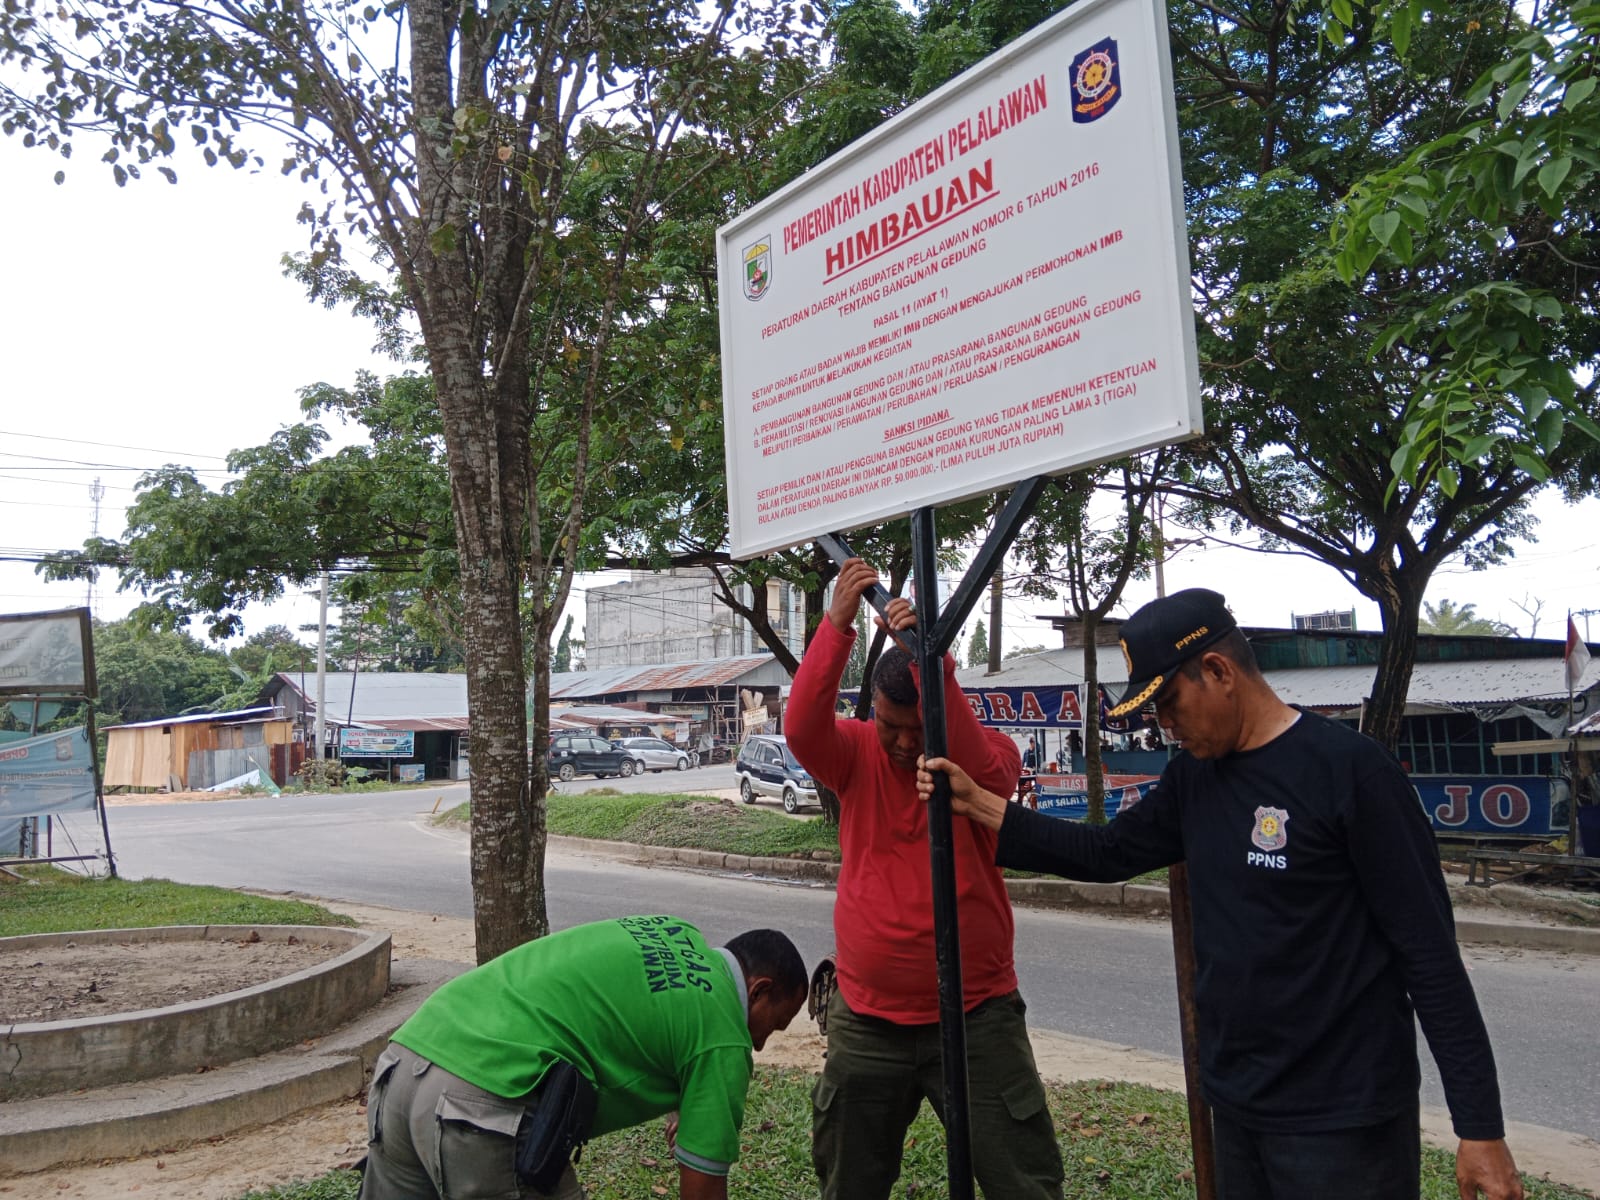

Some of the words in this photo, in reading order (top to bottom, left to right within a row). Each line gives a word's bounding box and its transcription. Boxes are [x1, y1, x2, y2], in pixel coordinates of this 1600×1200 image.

[783, 185, 861, 253] PEMERINTAH
[862, 134, 945, 209] KABUPATEN
[947, 74, 1047, 160] PELALAWAN
[761, 306, 810, 336] PERATURAN
[811, 289, 847, 315] DAERAH
[849, 260, 904, 295] KABUPATEN
[906, 229, 969, 269] PELALAWAN
[971, 204, 1014, 236] NOMOR
[1016, 199, 1024, 214] 6
[1026, 177, 1068, 207] TAHUN
[1070, 160, 1099, 187] 2016
[825, 157, 993, 275] HIMBAUAN
[751, 383, 774, 400] SETIAP
[775, 374, 798, 390] ORANG
[799, 367, 816, 379] ATAU
[817, 354, 843, 371] BADAN
[843, 343, 867, 359] WAJIB
[867, 329, 902, 350] MEMILIKI
[903, 319, 921, 334] IMB
[922, 303, 958, 326] DENGAN
[959, 274, 1024, 311] MENGAJUKAN
[1025, 241, 1098, 280] PERMOHONAN
[1099, 229, 1123, 249] IMB
[838, 288, 880, 315] TENTANG
[882, 260, 939, 297] BANGUNAN
[940, 237, 987, 270] GEDUNG
[872, 309, 899, 327] PASAL
[901, 303, 911, 314] 11
[912, 290, 937, 310] (AYAT
[940, 287, 949, 297] 1)
[752, 395, 778, 412] KEPADA
[777, 385, 801, 403] BUPATI
[802, 375, 825, 392] UNTUK
[826, 355, 872, 383] MELAKUKAN
[873, 339, 912, 362] KEGIATAN
[760, 406, 811, 432] PEMBANGUNAN
[812, 390, 852, 414] BANGUNAN
[853, 376, 885, 396] GEDUNG
[886, 370, 903, 384] DAN
[908, 360, 930, 375] ATAU
[931, 336, 986, 365] PRASARANA
[987, 315, 1041, 344] BANGUNAN
[1043, 294, 1088, 322] GEDUNG
[761, 422, 805, 445] REHABILITASI
[809, 406, 844, 426] RENOVASI
[845, 389, 888, 413] BANGUNAN
[888, 376, 923, 396] GEDUNG
[925, 368, 943, 382] DAN
[949, 357, 972, 374] ATAU
[973, 334, 1031, 364] PRASARANA
[1033, 309, 1091, 341] BANGUNAN
[1093, 289, 1142, 317] GEDUNG
[762, 439, 792, 457] MELIPUTI
[792, 424, 832, 445] PERBAIKAN
[836, 405, 881, 428] PERAWATAN
[886, 384, 938, 410] PERUBAHAN
[943, 361, 997, 388] PERLUASAN
[1003, 329, 1081, 368] PENGURANGAN
[757, 485, 778, 499] SETIAP
[779, 476, 805, 491] PEMILIK
[806, 471, 821, 483] DAN
[825, 464, 844, 478] ATAU
[845, 451, 887, 471] PENGGUNA
[888, 434, 934, 457] BANGUNAN
[935, 421, 972, 441] GEDUNG
[974, 412, 999, 428] YANG
[1001, 402, 1029, 419] TIDAK
[1031, 382, 1086, 409] MEMENUHI
[1088, 359, 1157, 390] KETENTUAN
[757, 498, 779, 512] DALAM
[780, 485, 820, 503] PERATURAN
[820, 475, 850, 491] DAERAH
[851, 472, 862, 482] INI
[862, 459, 898, 479] DIANCAM
[899, 448, 934, 467] DENGAN
[935, 437, 967, 455] PIDANA
[968, 420, 1022, 444] KURUNGAN
[1023, 407, 1059, 427] PALING
[1061, 397, 1092, 416] LAMA
[1094, 393, 1101, 406] 3
[1102, 382, 1137, 406] (TIGA)
[758, 511, 780, 523] BULAN
[779, 506, 797, 516] ATAU
[798, 497, 821, 511] DENDA
[821, 489, 848, 503] PALING
[848, 479, 879, 496] BANYAK
[880, 475, 892, 487] RP.
[939, 452, 963, 470] (LIMA
[965, 443, 996, 460] PULUH
[997, 436, 1021, 451] JUTA
[1022, 422, 1064, 443] RUPIAH)
[883, 420, 915, 441] SANKSI
[917, 408, 950, 429] PIDANA
[1174, 626, 1209, 650] PPNS
[962, 691, 1047, 722] ERA
[1413, 784, 1531, 828] JO
[1247, 851, 1287, 869] PPNS
[651, 916, 712, 992] SATGAS
